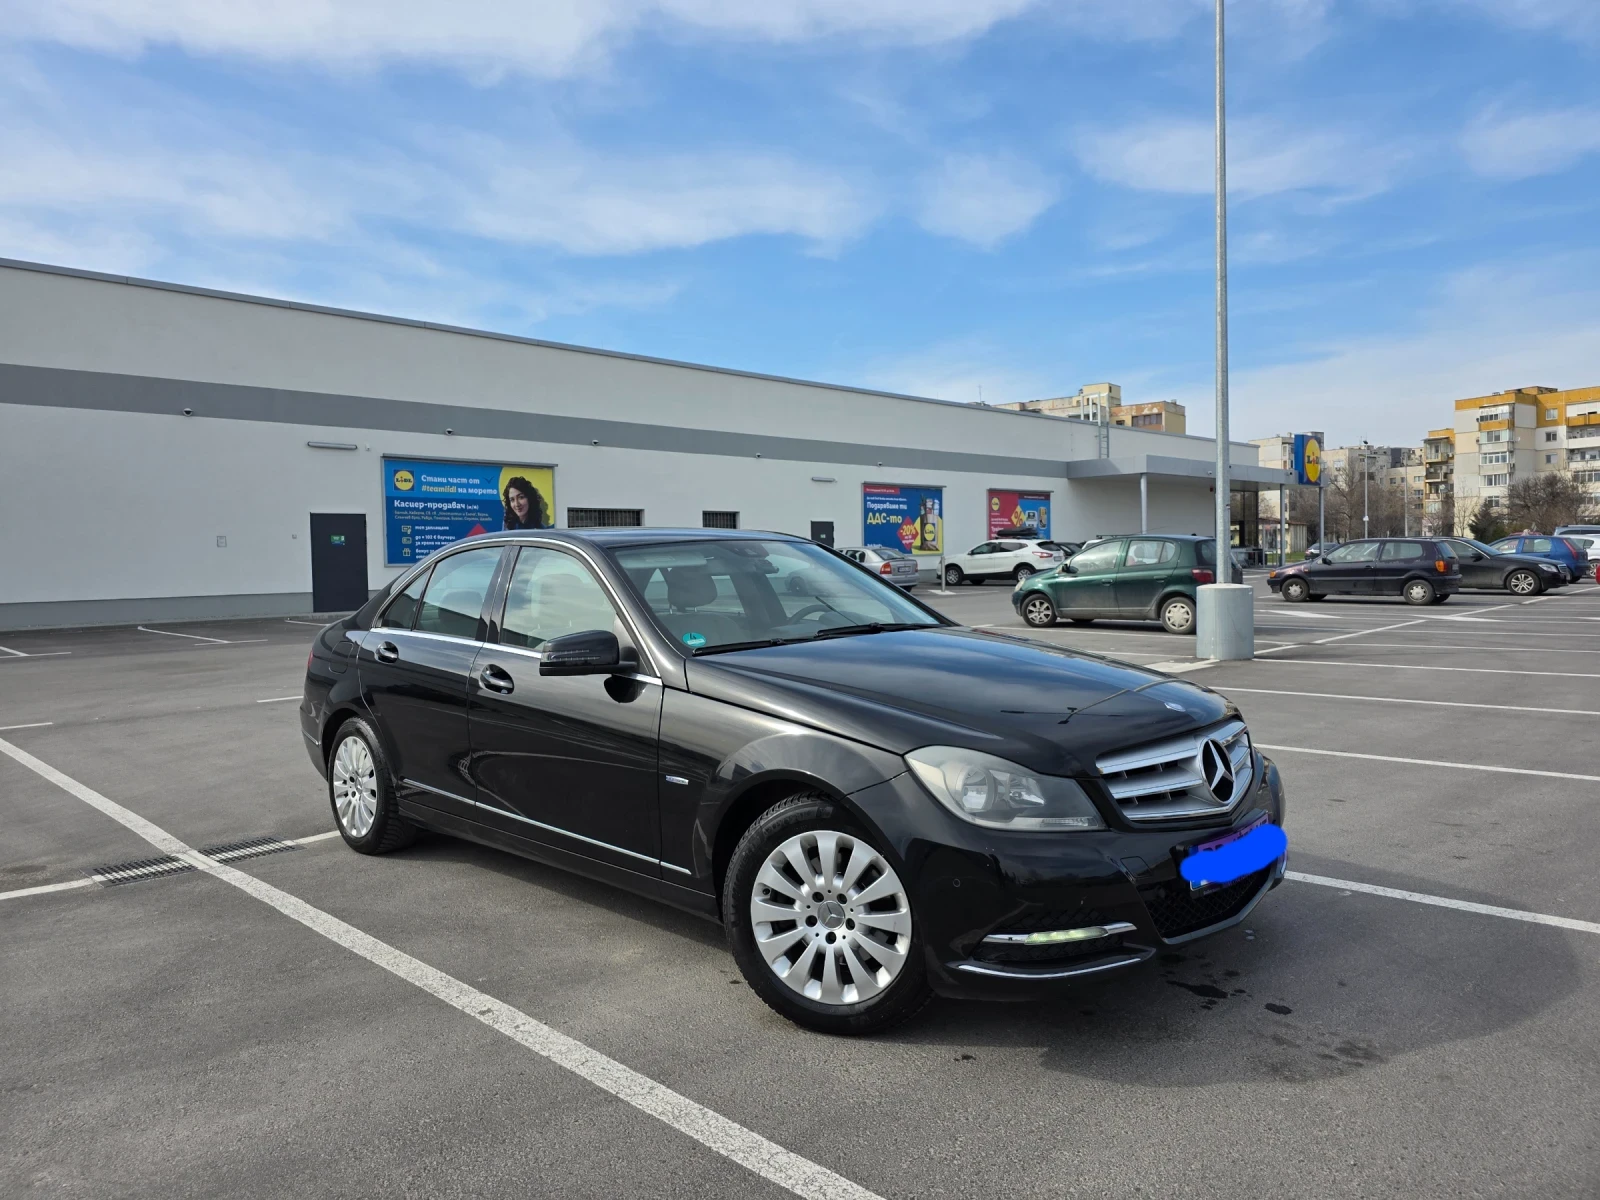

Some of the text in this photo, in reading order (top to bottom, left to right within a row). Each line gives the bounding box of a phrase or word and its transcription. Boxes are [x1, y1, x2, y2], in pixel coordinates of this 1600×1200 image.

[421, 475, 447, 483] Стани
[468, 488, 498, 496] морето
[394, 499, 466, 511] Касиер-продавач
[866, 512, 902, 525] ДДС-то
[900, 525, 916, 536] -20%
